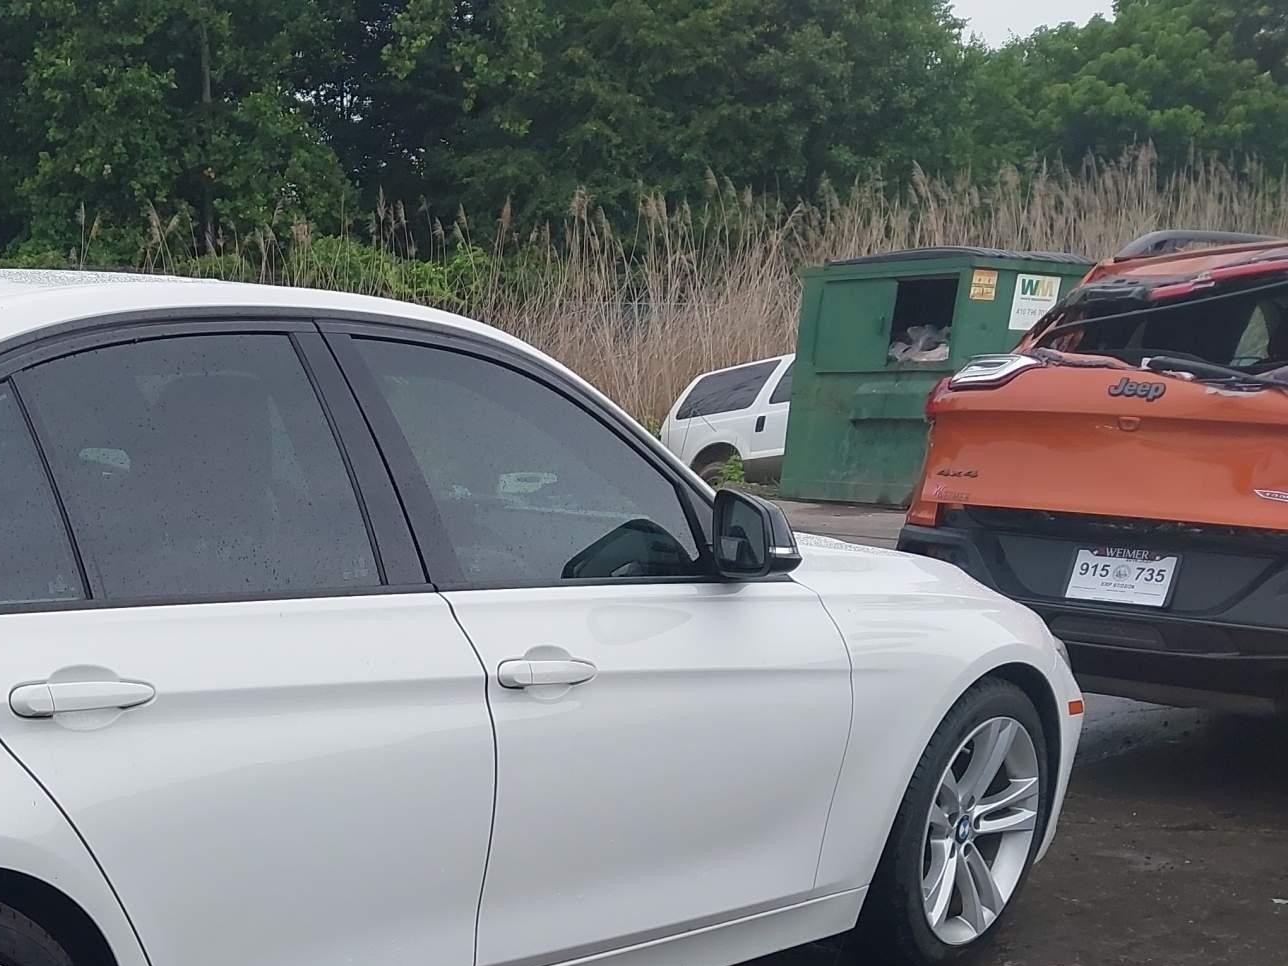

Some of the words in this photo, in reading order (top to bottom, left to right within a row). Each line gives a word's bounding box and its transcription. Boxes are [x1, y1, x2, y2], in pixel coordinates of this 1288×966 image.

[1021, 278, 1055, 297] WM
[1108, 377, 1167, 402] Jeep
[1106, 547, 1150, 560] WEIMER
[1078, 562, 1111, 578] 915
[1134, 567, 1167, 583] 735
